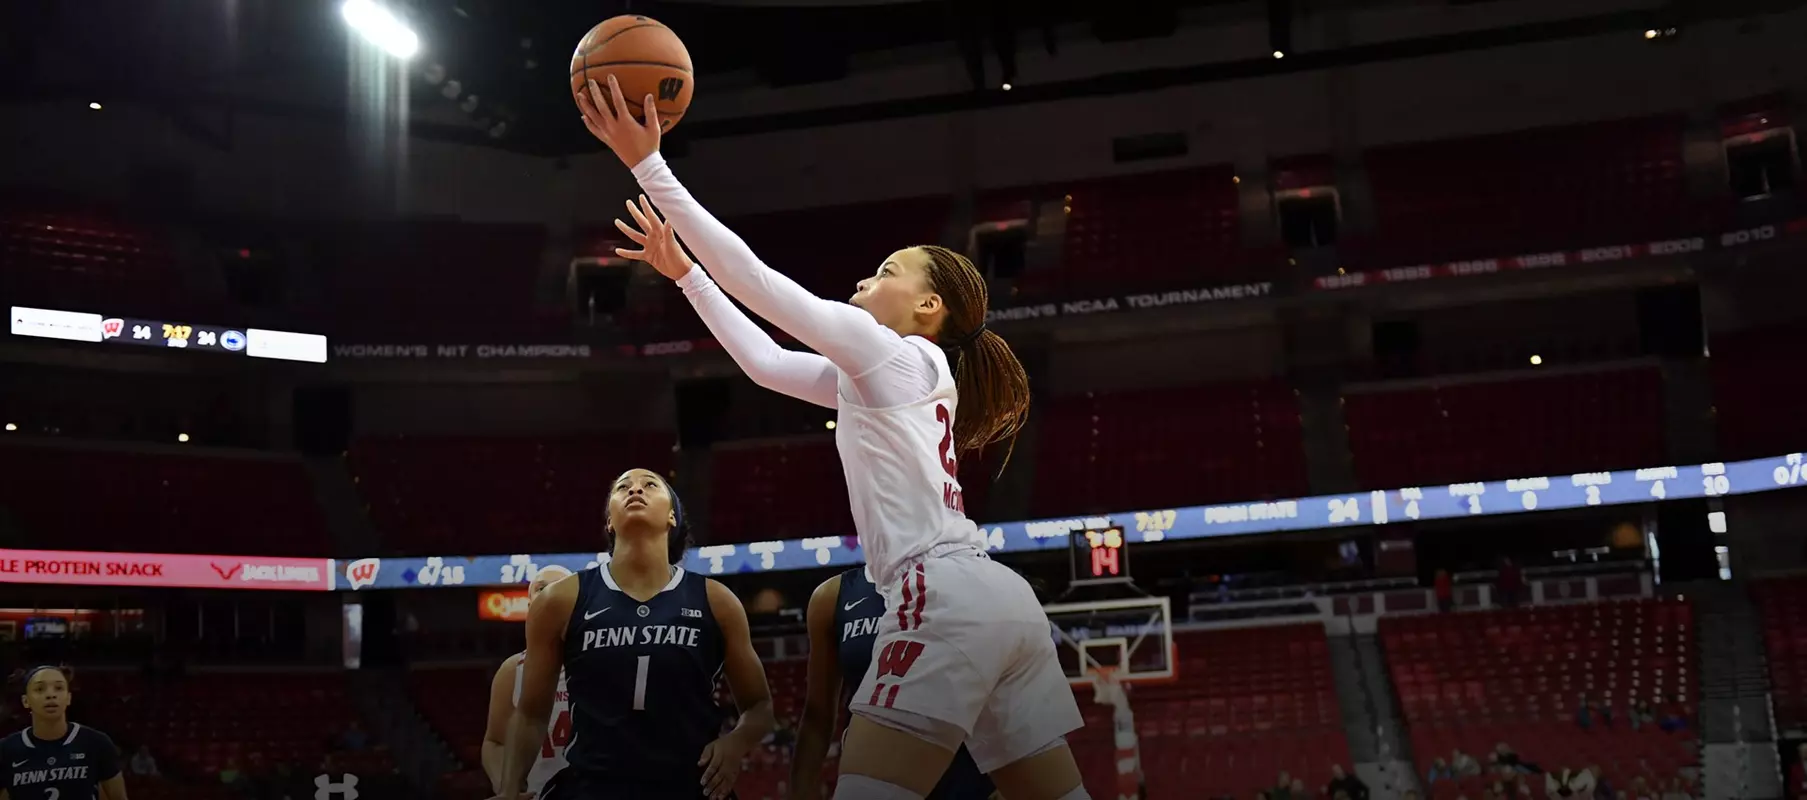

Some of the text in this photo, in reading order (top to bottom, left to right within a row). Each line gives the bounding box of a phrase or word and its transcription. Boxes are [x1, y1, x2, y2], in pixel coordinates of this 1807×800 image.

[1721, 225, 1775, 247] 2010
[986, 281, 1273, 322] OMEN'S NCAA TOURNAMENT
[333, 343, 592, 358] WOMEN'S NIT CHAMPIONS
[936, 404, 957, 479] 2
[1522, 490, 1537, 510] 0
[1651, 480, 1665, 499] 4
[1135, 510, 1177, 532] 7:17
[1205, 501, 1298, 524] PENN STATE
[1328, 498, 1360, 523] 24
[25, 561, 100, 575] PROTEIN
[106, 563, 163, 577] SNACK
[351, 563, 376, 582] W
[1092, 548, 1119, 576] 14
[582, 625, 701, 651] PENN STATE
[876, 640, 925, 680] W
[633, 655, 650, 710] 1
[12, 765, 89, 787] PENN STATE
